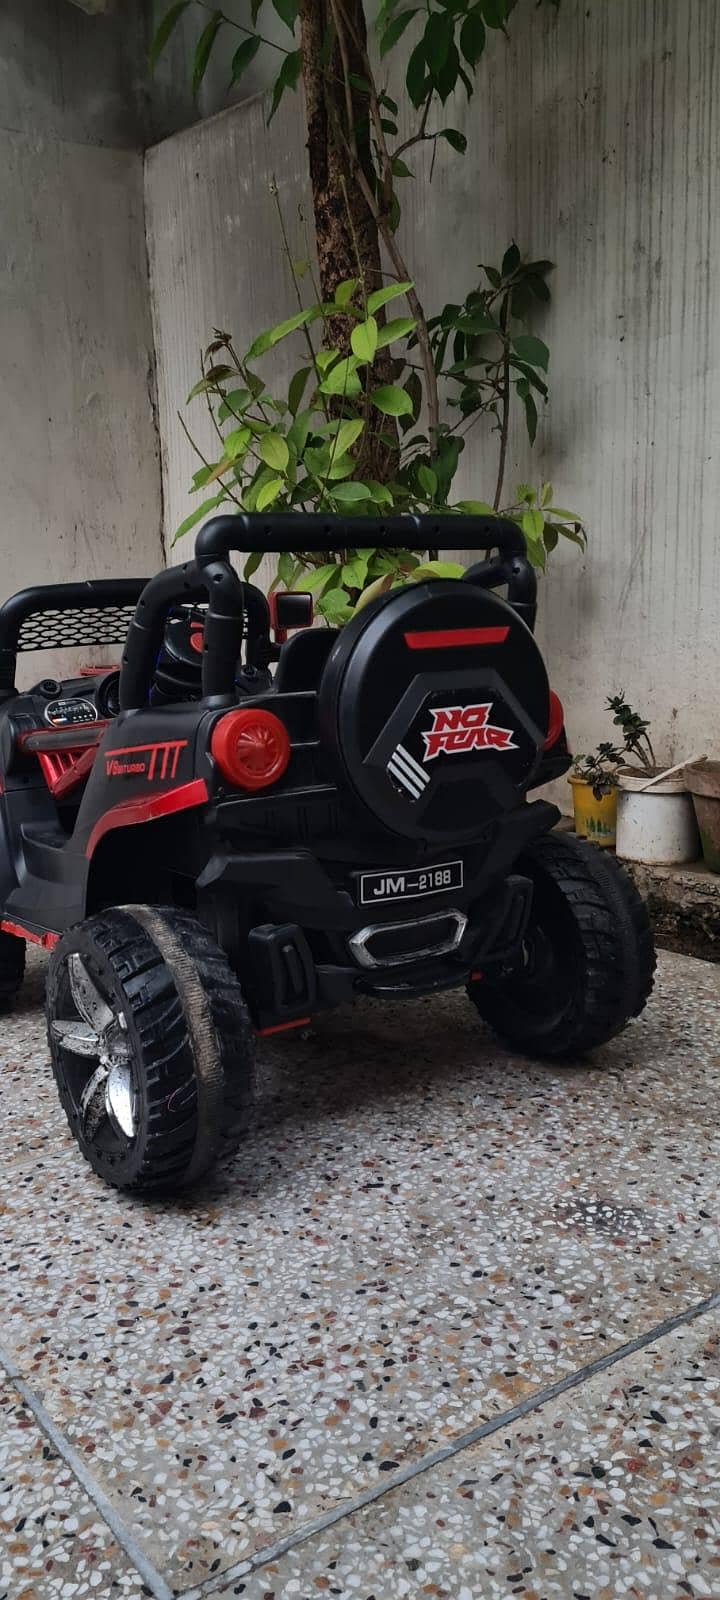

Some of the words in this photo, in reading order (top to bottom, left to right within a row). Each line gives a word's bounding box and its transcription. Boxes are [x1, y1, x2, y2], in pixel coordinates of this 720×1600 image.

[430, 703, 492, 732] NO
[422, 726, 518, 761] FEAR
[373, 869, 452, 896] JM-2188
